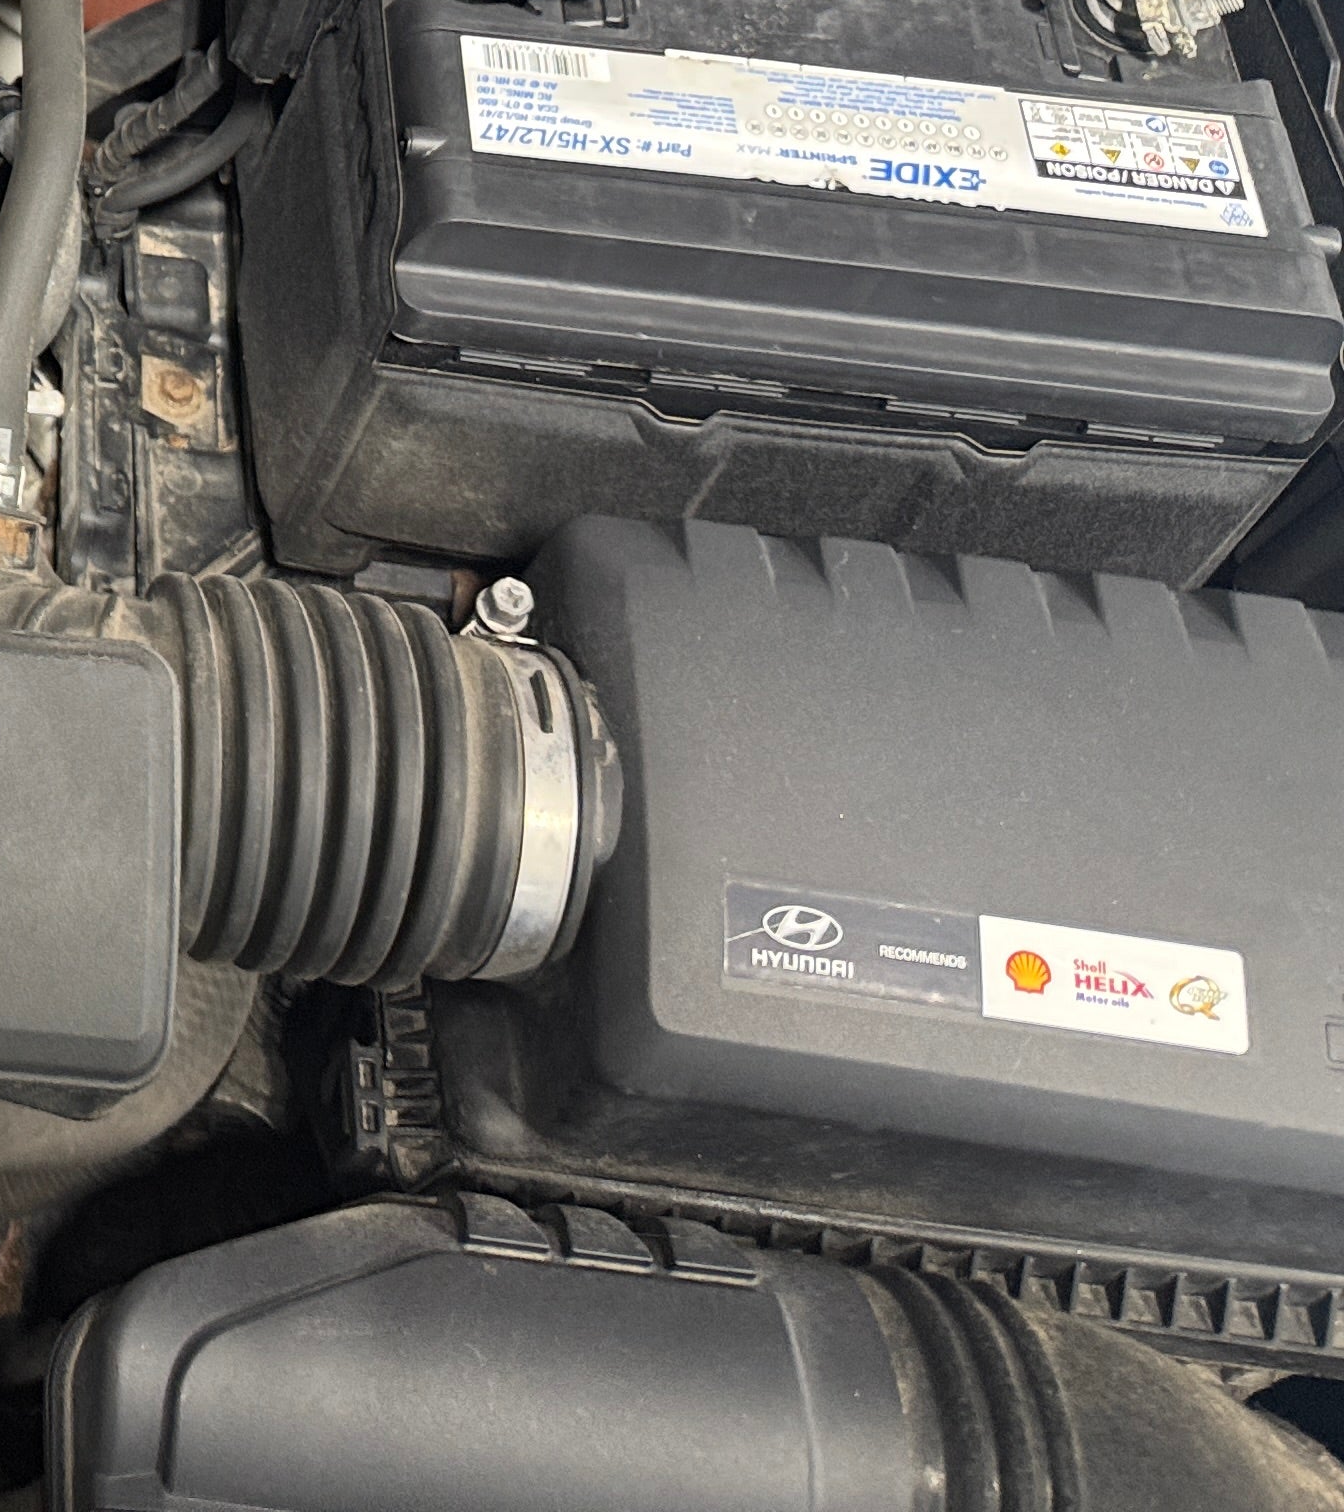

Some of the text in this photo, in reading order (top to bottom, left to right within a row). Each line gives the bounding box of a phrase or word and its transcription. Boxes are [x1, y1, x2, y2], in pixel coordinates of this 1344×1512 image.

[513, 79, 526, 88] 20
[543, 81, 558, 90] Ah
[538, 93, 553, 101] RC
[538, 104, 559, 113] CCA
[479, 110, 593, 129] Group Size: H5/L2/47
[480, 123, 692, 158] Part #: SX-H5/L2/47
[736, 144, 858, 166] SPRINTER MAX
[869, 158, 987, 191] EXIDE
[1046, 162, 1122, 183] POISON
[1132, 172, 1215, 194] DANGER
[751, 947, 855, 980] HYUNDAI
[878, 944, 968, 970] RECOMMENDS
[1073, 958, 1107, 974] Shell
[1074, 972, 1154, 999] HELIX
[1075, 992, 1130, 1008] Motor oils
